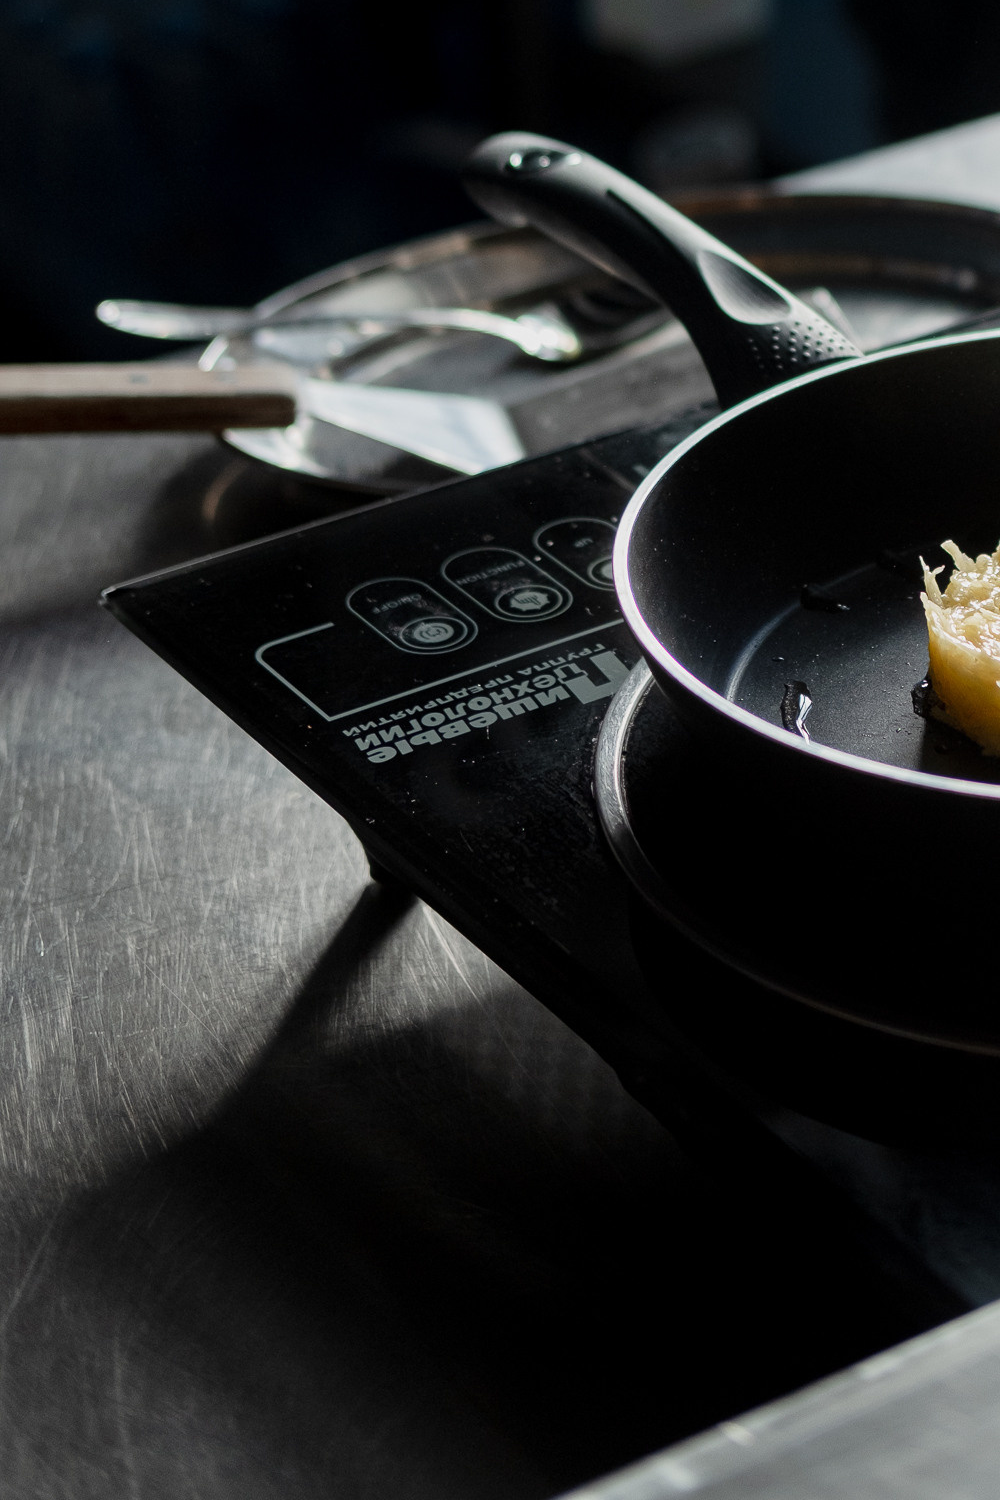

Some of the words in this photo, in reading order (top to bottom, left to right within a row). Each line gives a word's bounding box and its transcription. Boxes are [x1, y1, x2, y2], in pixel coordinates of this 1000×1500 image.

[574, 537, 593, 548] UP
[457, 560, 526, 586] FUNCTION
[373, 593, 422, 615] ON/OFF
[517, 643, 606, 675] ГРУППА
[342, 674, 519, 738] ПРЕДПРИЯТИЙ
[366, 650, 634, 764] Пищевые
